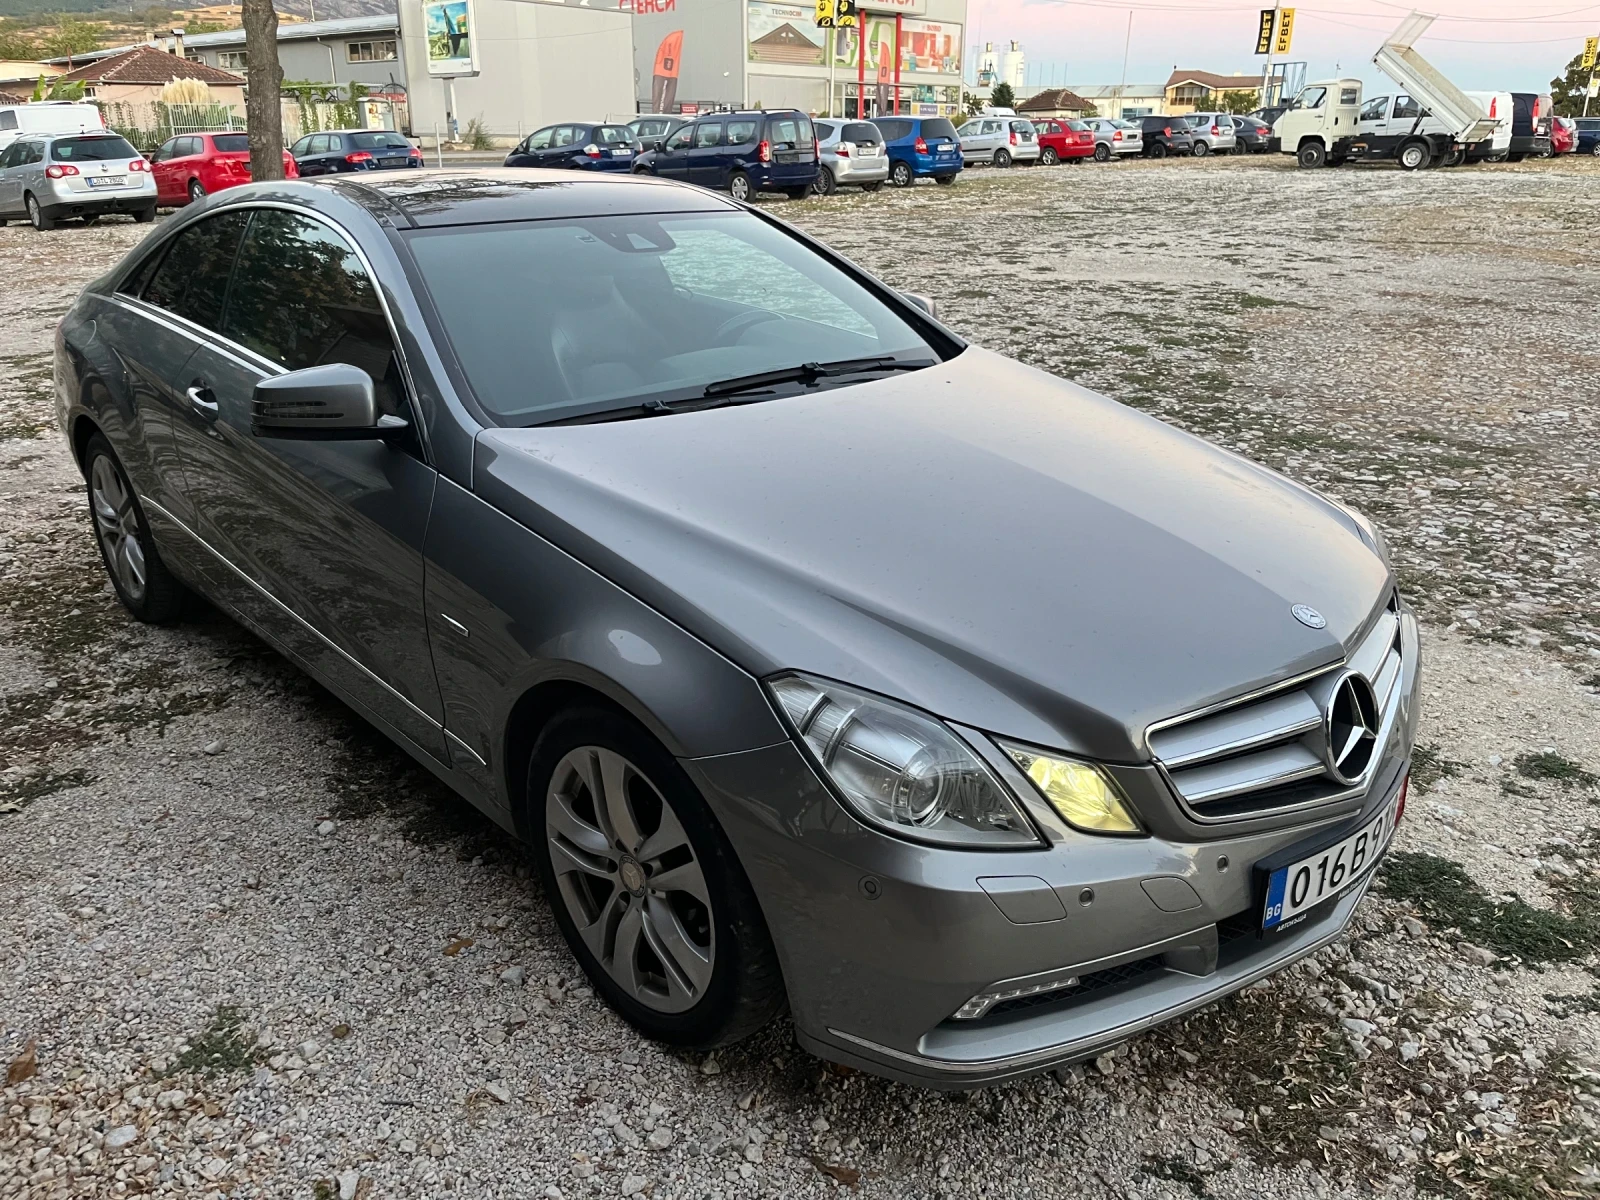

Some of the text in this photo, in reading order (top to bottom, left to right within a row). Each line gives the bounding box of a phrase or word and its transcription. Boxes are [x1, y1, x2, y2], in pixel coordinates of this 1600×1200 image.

[1258, 12, 1272, 52] EFBET
[1277, 12, 1291, 52] EFBET
[1265, 903, 1282, 921] BG
